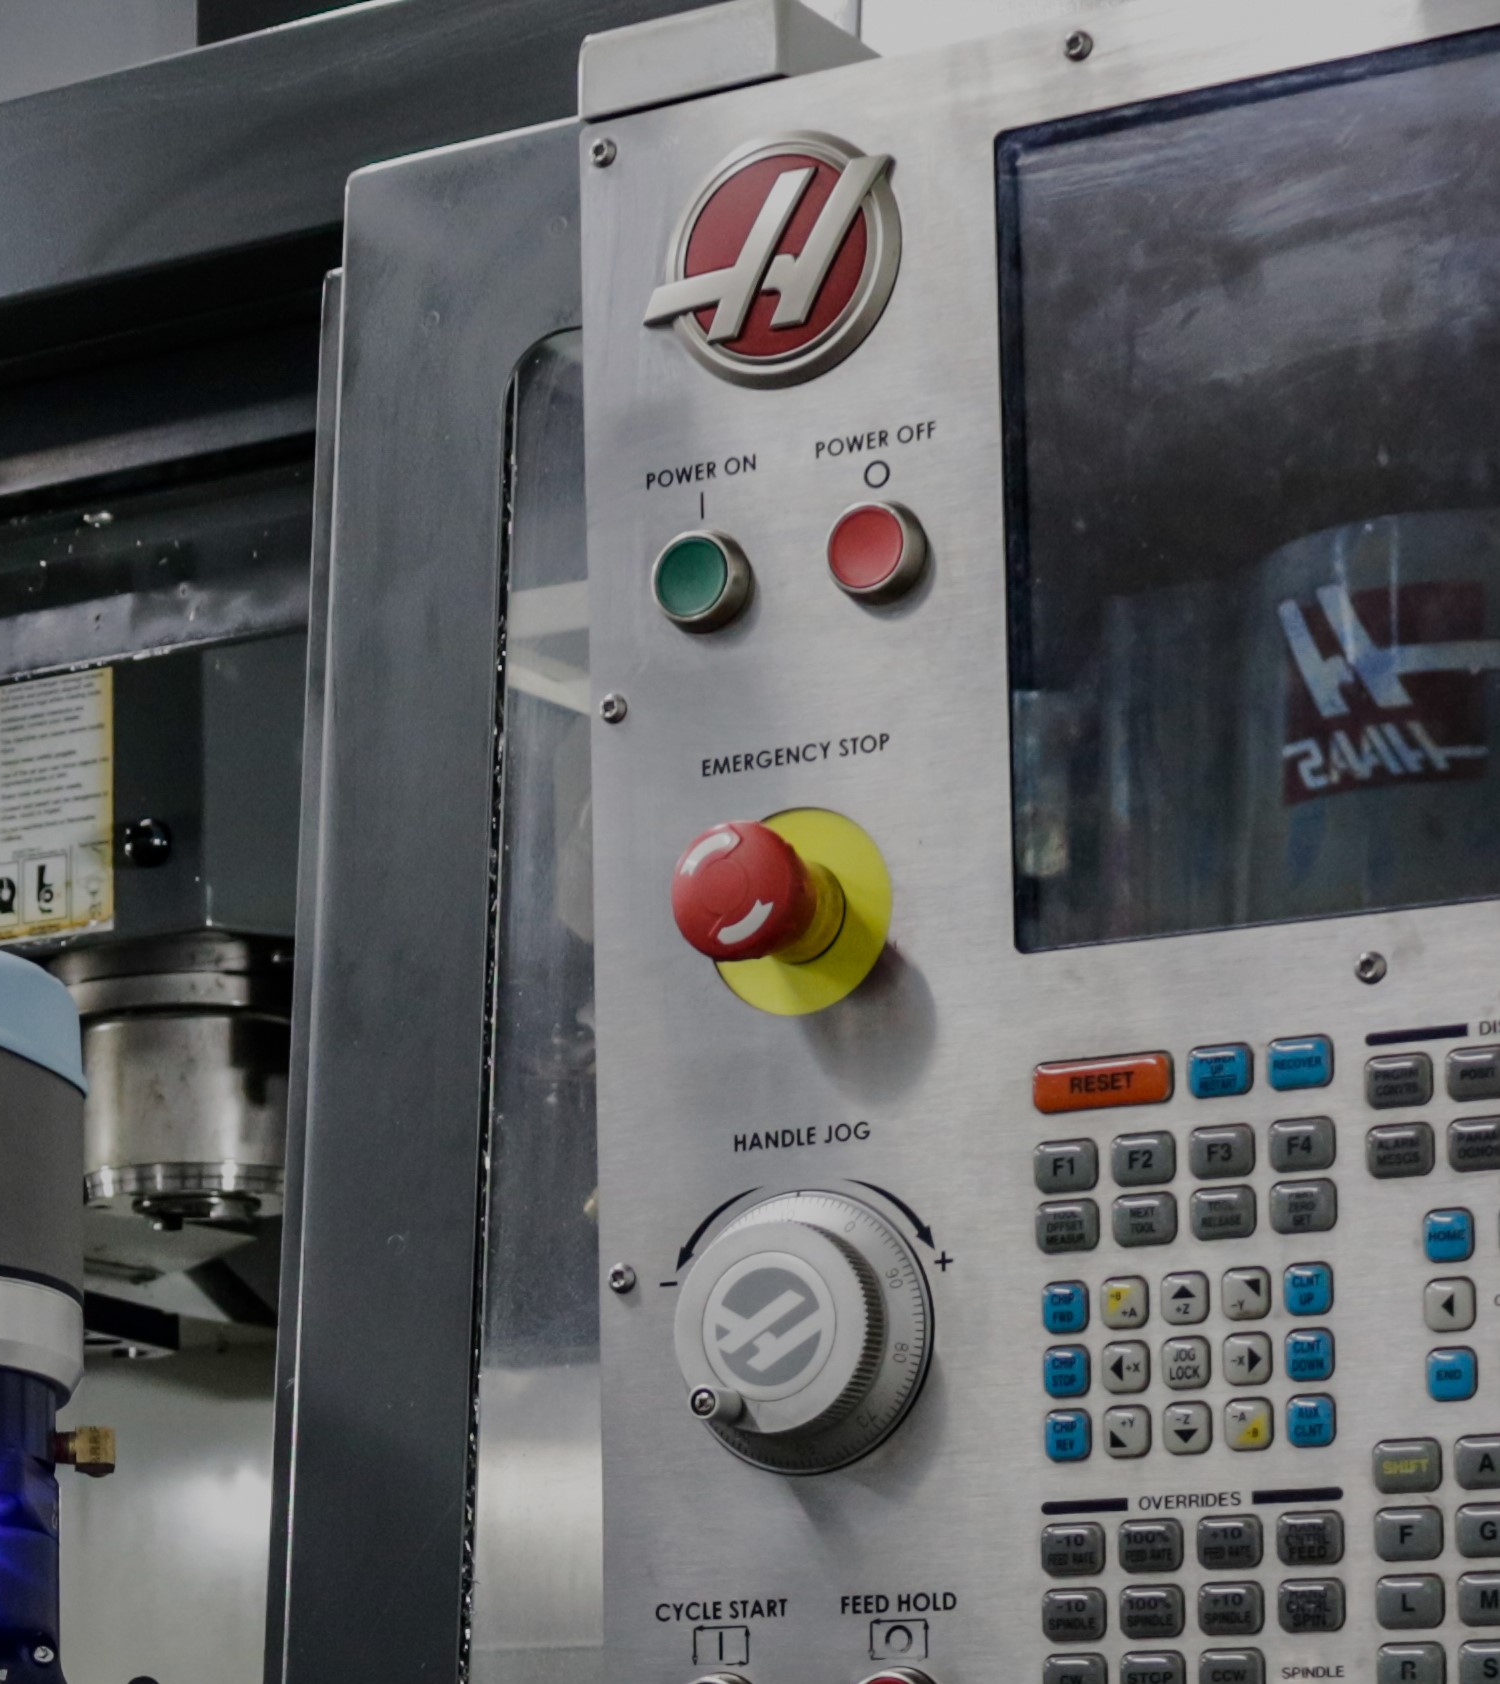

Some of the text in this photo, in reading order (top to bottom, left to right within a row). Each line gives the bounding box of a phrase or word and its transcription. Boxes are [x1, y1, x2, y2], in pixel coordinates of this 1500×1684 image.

[815, 420, 936, 459] POWER OFF
[646, 454, 757, 491] POWER ON
[701, 733, 890, 778] EMERGENCY STOP
[1273, 1056, 1321, 1070] RECOVER
[1069, 1071, 1134, 1094] RESET
[734, 1121, 871, 1152] HANDLE JOG
[1206, 1143, 1232, 1162] F3
[1287, 1136, 1312, 1155] F4
[1053, 1158, 1075, 1176] F1
[1128, 1150, 1153, 1170] F2
[1130, 1221, 1155, 1234] TOOL
[1428, 1230, 1465, 1242] HOME
[1231, 1300, 1244, 1311] -Y
[1299, 1292, 1314, 1305] UP
[1121, 1308, 1137, 1318] +A
[1175, 1303, 1190, 1315] +Z
[1052, 1310, 1073, 1323] FWD
[1172, 1350, 1196, 1362] JOG
[1231, 1355, 1245, 1366] -X
[1052, 1358, 1076, 1370] CHIP
[1126, 1362, 1140, 1373] +X
[1292, 1359, 1324, 1372] DOWN
[1169, 1365, 1199, 1380] LOCK
[1436, 1369, 1463, 1381] END
[1051, 1374, 1076, 1387] STOP
[1120, 1417, 1135, 1428] +Y
[1175, 1414, 1190, 1425] -Z
[1232, 1411, 1246, 1422] -A
[1052, 1422, 1076, 1434] CHIP
[1382, 1459, 1429, 1475] SHIFT
[1478, 1453, 1495, 1473] A
[1138, 1492, 1241, 1511] OVERRIDES
[1400, 1524, 1413, 1544] F
[1479, 1521, 1497, 1541] G
[840, 1592, 957, 1615] FEED HOLD
[1402, 1593, 1415, 1612] L
[1481, 1590, 1498, 1609] M
[655, 1598, 787, 1623] CYCLE START
[1281, 1666, 1345, 1680] SPINDLE
[1401, 1661, 1416, 1680] R
[1483, 1658, 1498, 1678] S
[1127, 1672, 1173, 1684] STOP
[1212, 1669, 1246, 1683] CCW
